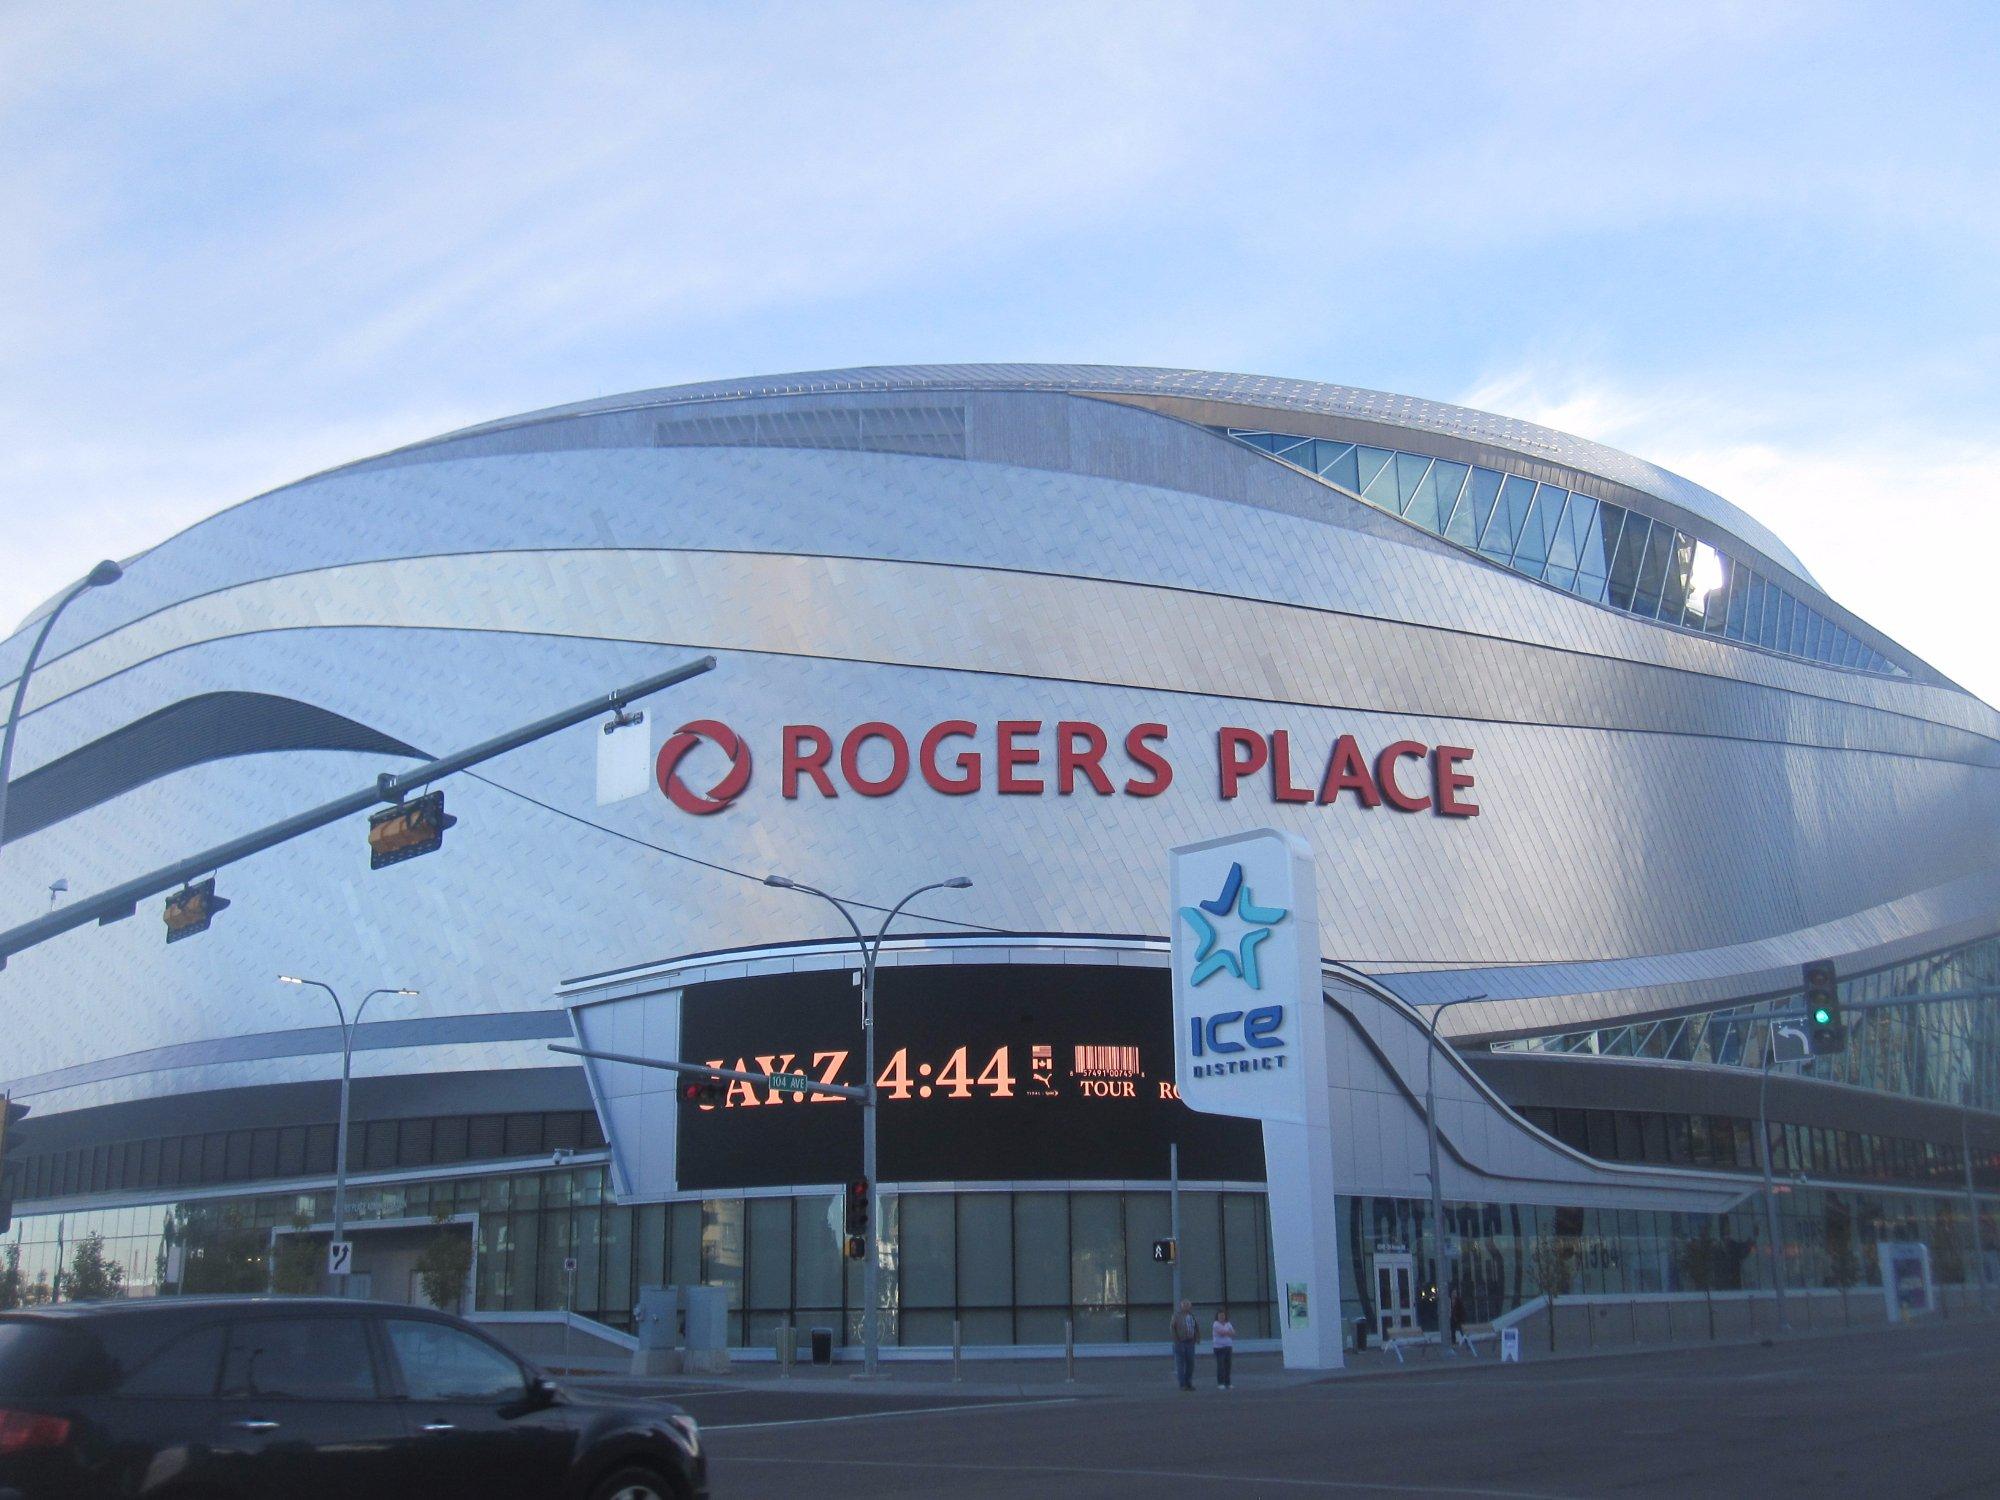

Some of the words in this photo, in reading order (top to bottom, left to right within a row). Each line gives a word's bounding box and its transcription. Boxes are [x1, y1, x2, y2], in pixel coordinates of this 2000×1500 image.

[783, 720, 1172, 797] ROGERS
[1221, 727, 1480, 817] PLACE
[875, 1045, 1016, 1100] 4:44
[1193, 1055, 1287, 1078] DISTRICT
[772, 1075, 787, 1087] 104
[790, 1077, 805, 1090] AVE
[1079, 1080, 1136, 1097] TOUR
